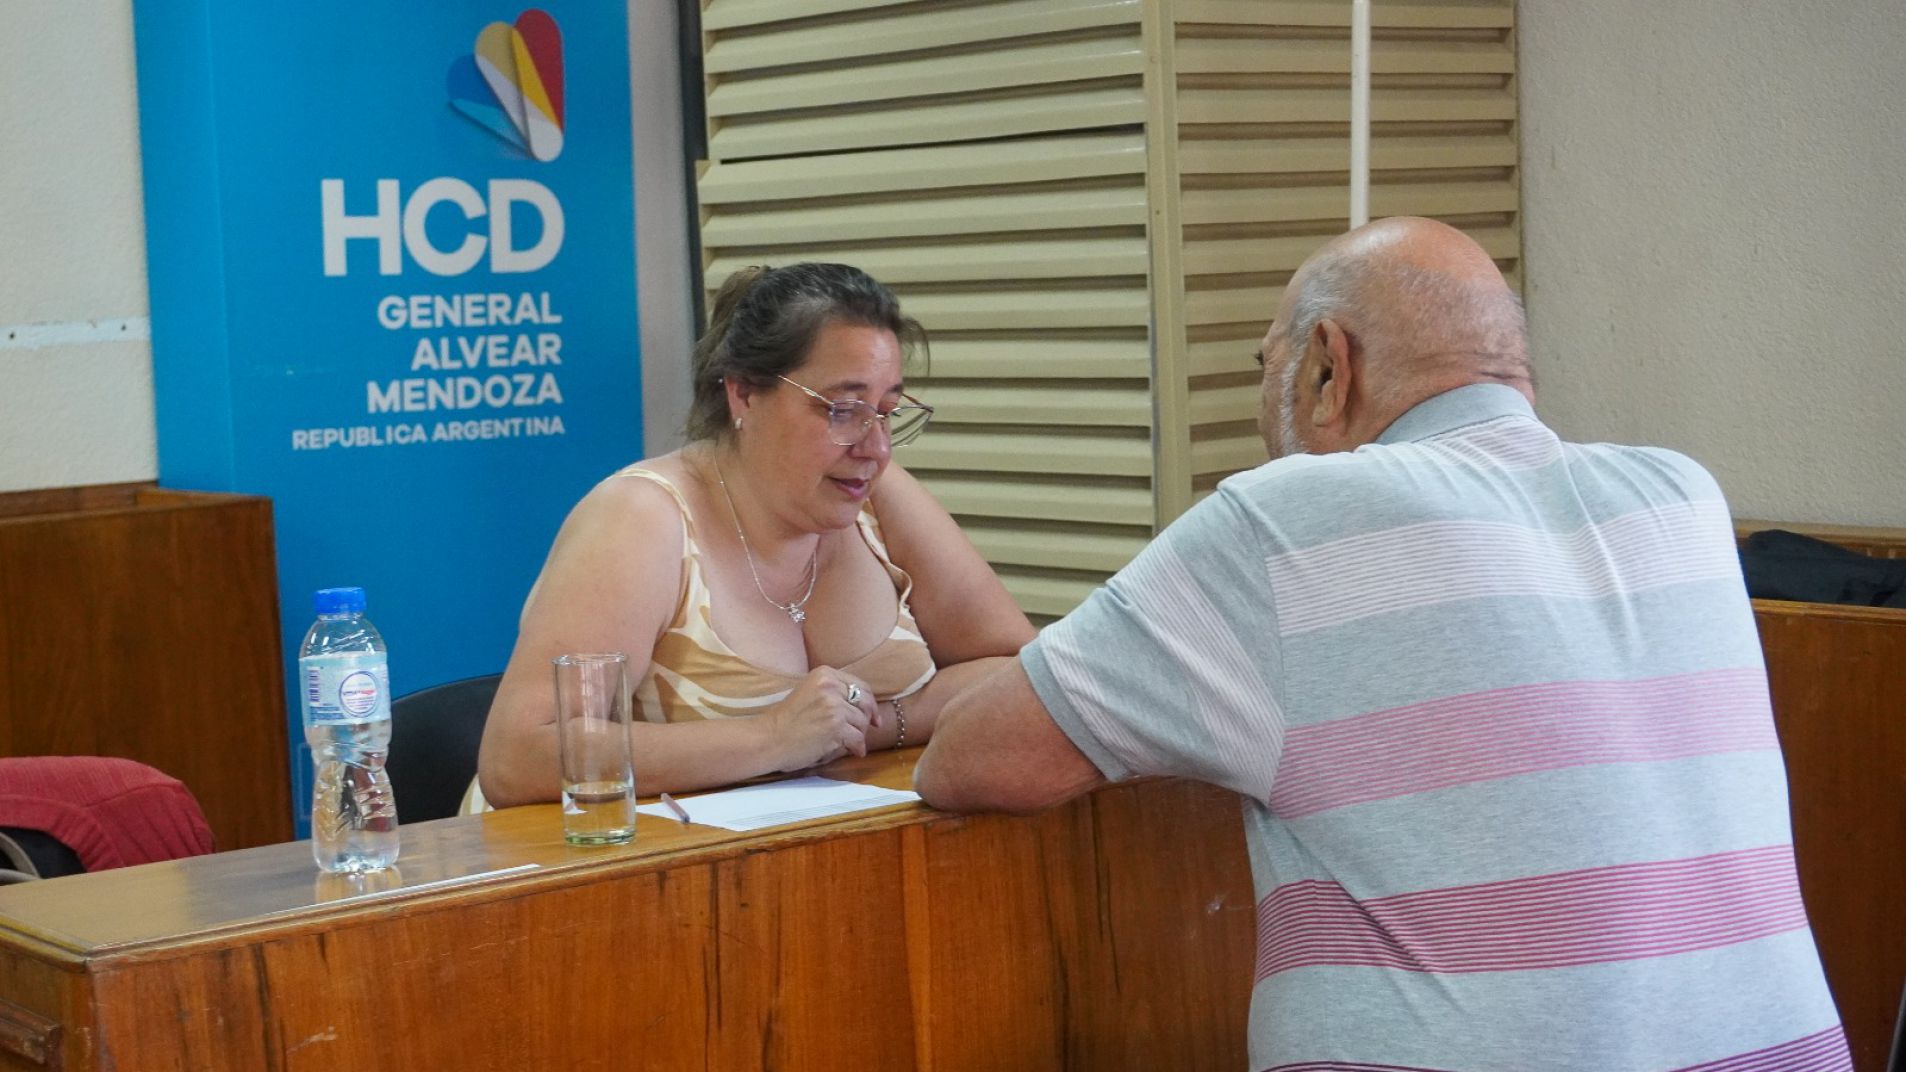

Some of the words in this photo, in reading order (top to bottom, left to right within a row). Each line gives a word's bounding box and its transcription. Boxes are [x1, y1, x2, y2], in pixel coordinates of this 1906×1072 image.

[321, 177, 565, 276] HCD
[378, 292, 562, 330] GENERAL
[411, 333, 562, 371] ALVEAR
[367, 373, 562, 413] MENDOZA
[292, 424, 427, 450] REPUBLICA
[432, 416, 565, 442] ARGENTINA
